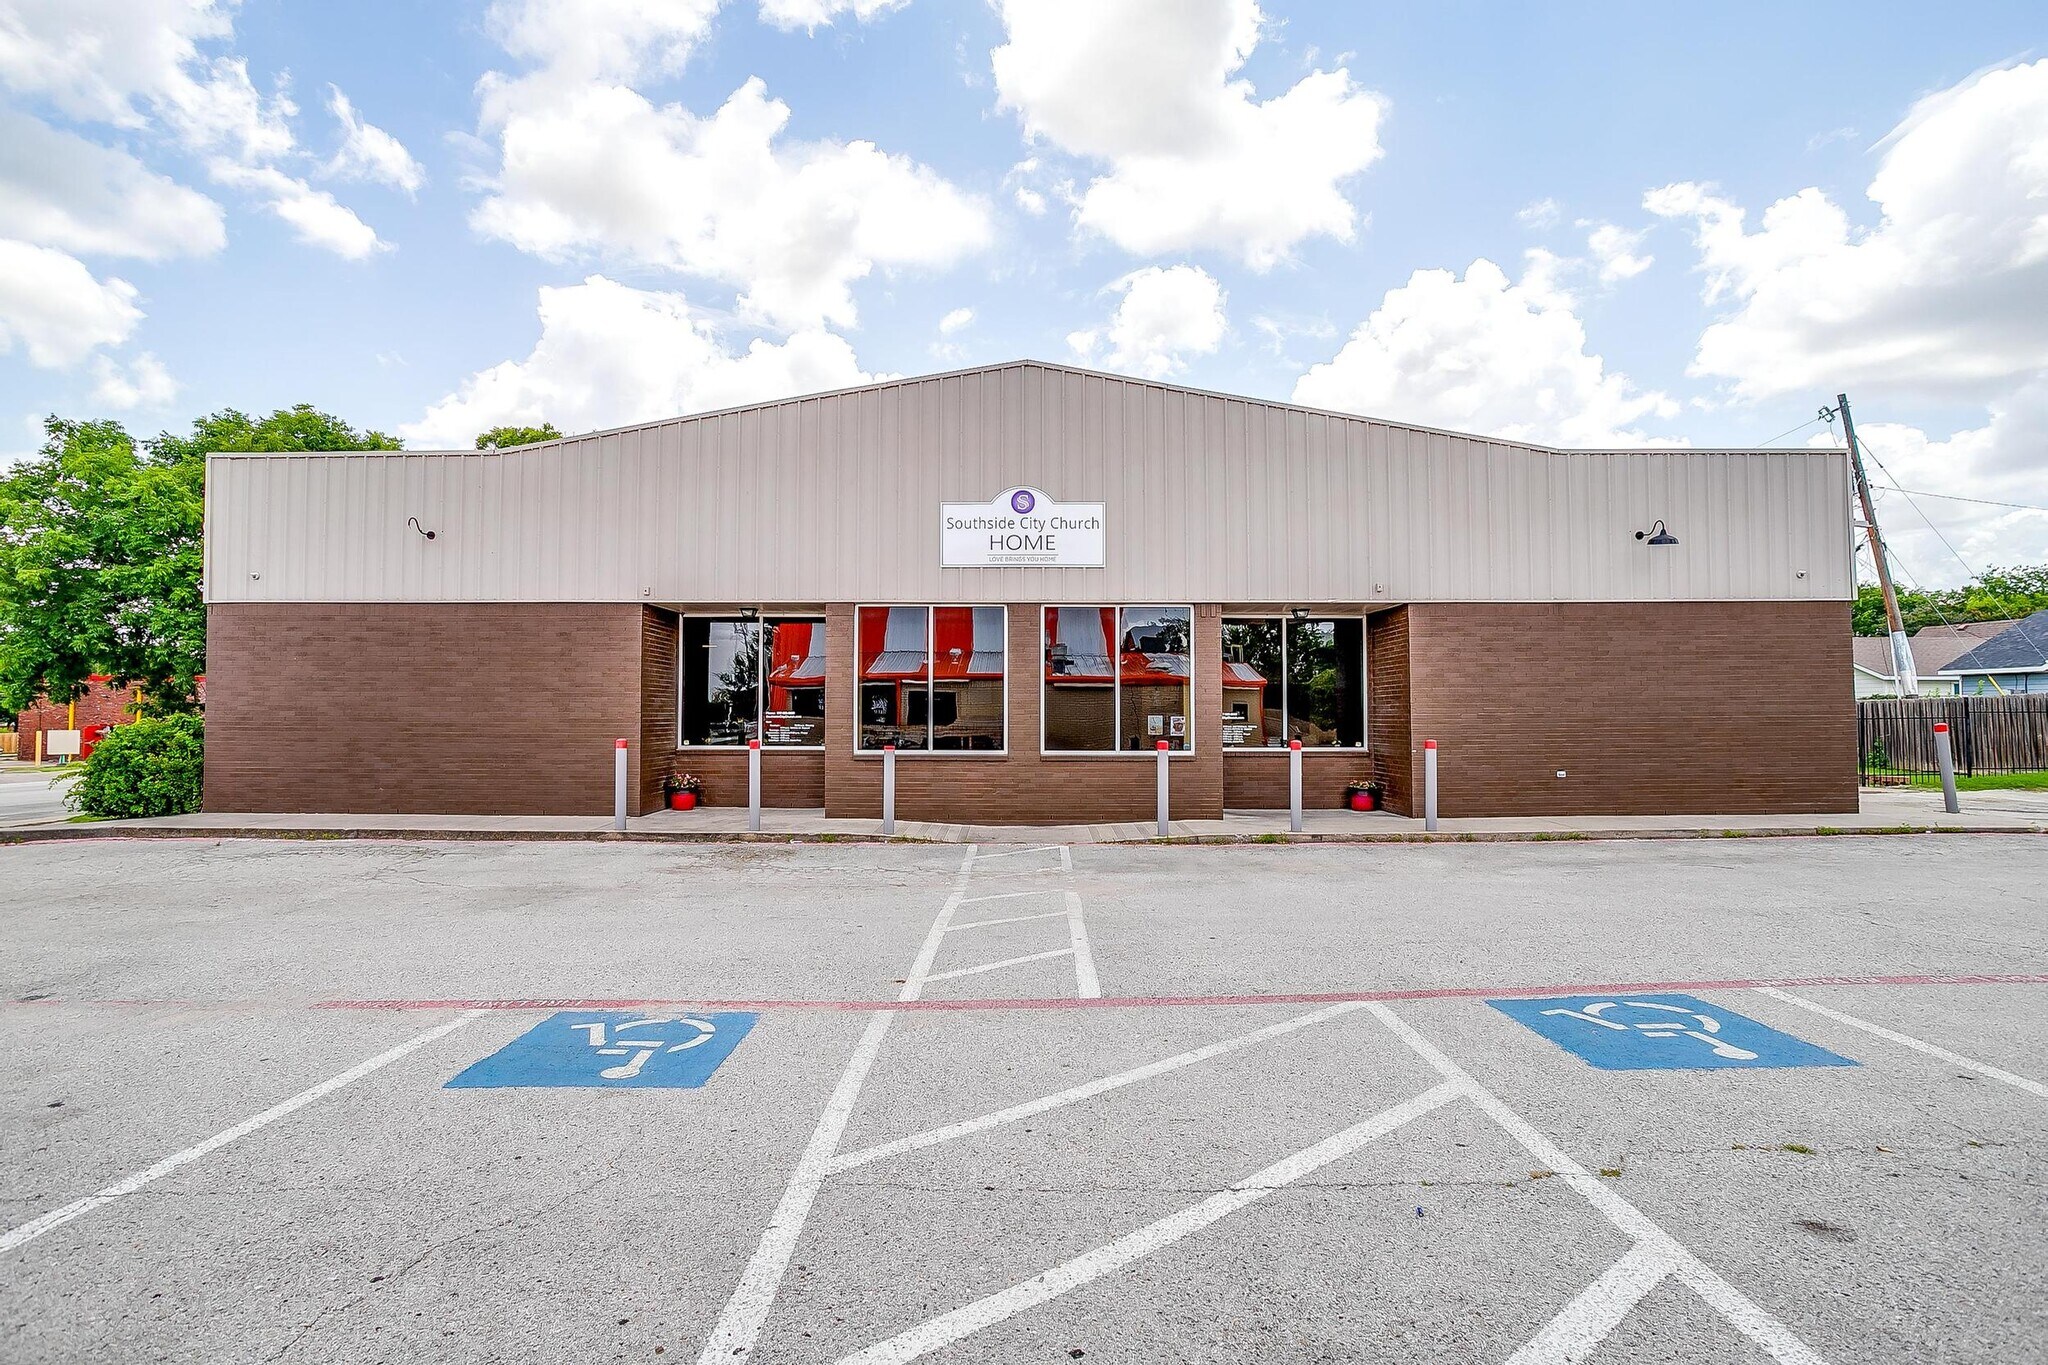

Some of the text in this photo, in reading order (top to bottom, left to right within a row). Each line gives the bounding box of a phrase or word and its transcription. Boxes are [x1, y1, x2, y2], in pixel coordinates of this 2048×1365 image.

[1016, 494, 1030, 511] S
[946, 516, 1100, 532] Southside City Church
[990, 534, 1056, 551] HOME
